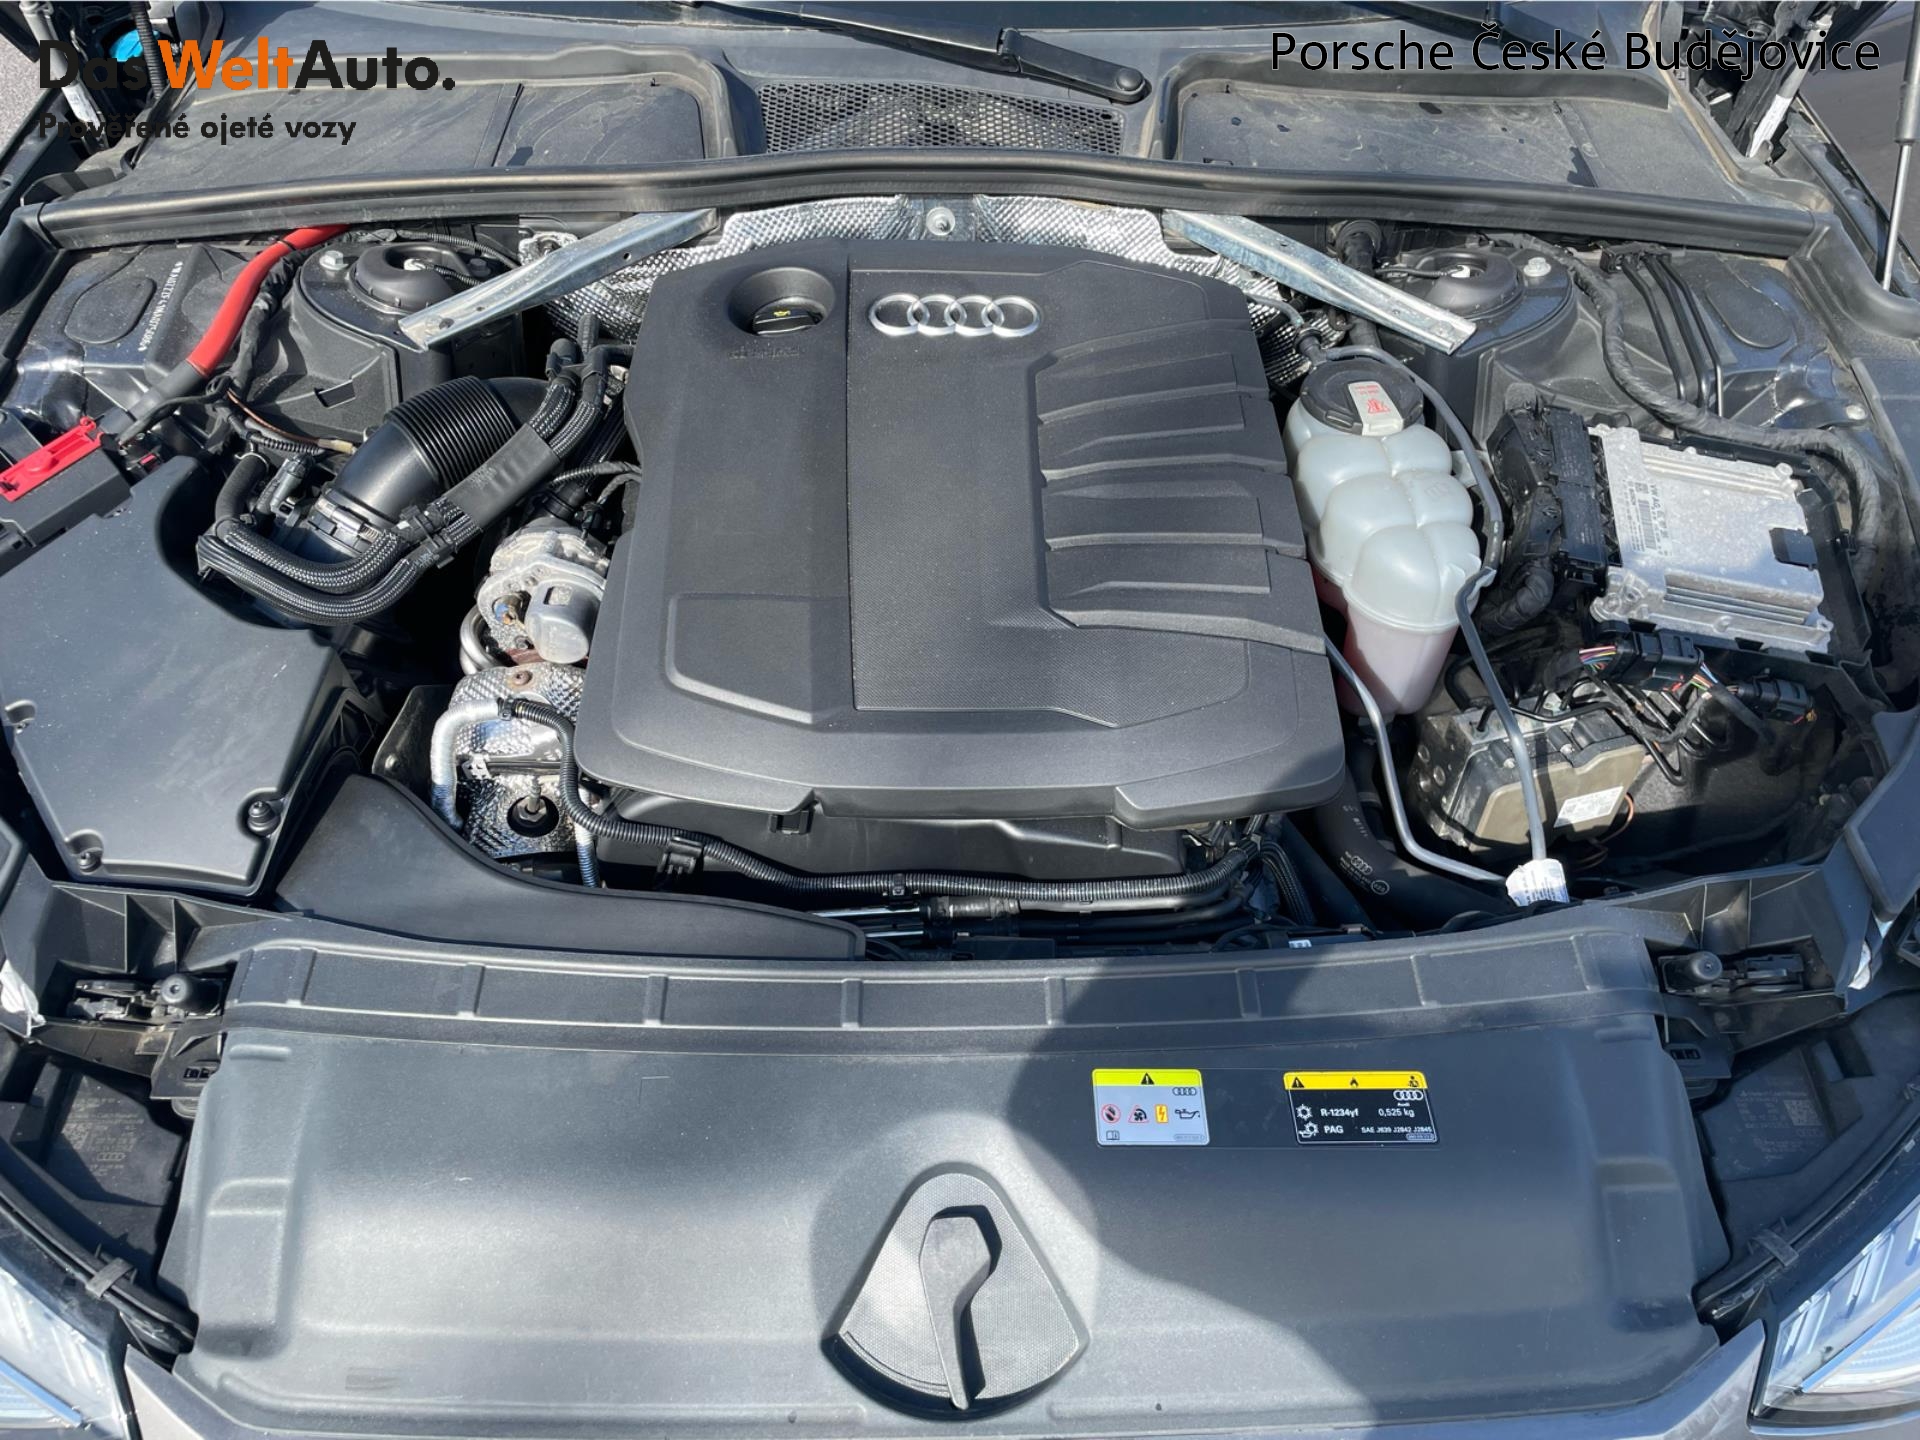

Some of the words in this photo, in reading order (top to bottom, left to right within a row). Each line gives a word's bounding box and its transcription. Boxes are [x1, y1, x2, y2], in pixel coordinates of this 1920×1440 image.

[1320, 1108, 1359, 1118] R-1234yf
[1378, 1108, 1402, 1117] 0,525
[1403, 1108, 1415, 1118] kg
[1323, 1125, 1344, 1134] PAG
